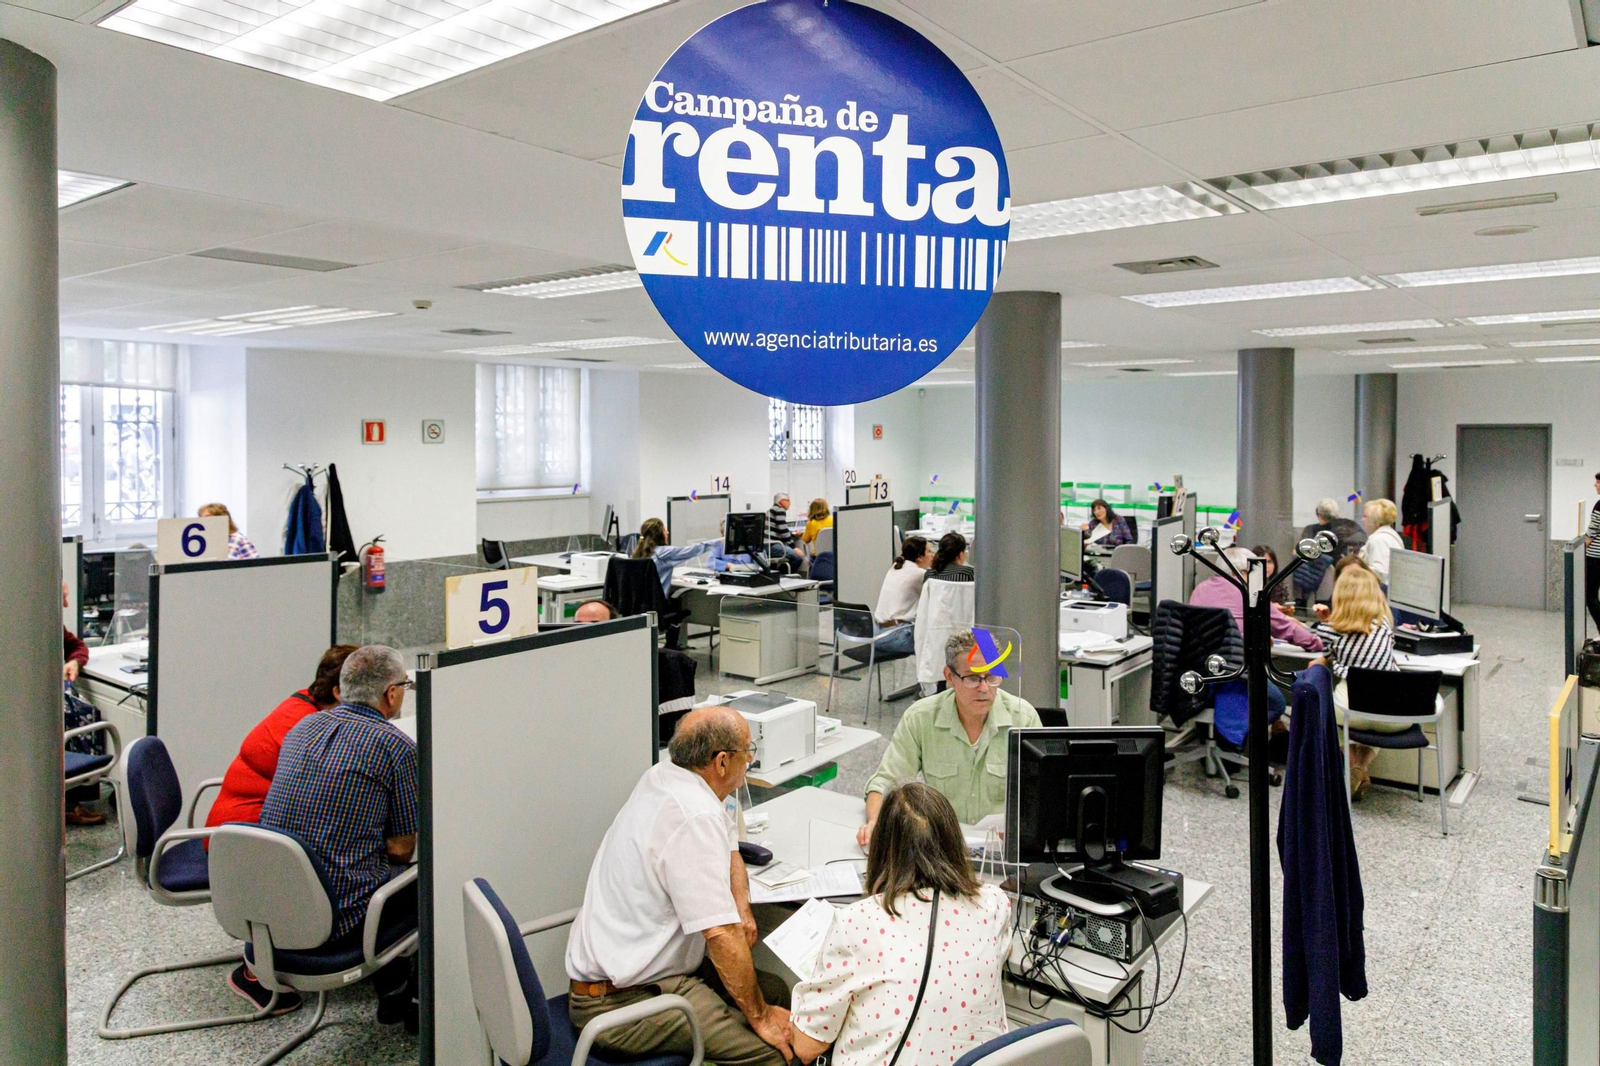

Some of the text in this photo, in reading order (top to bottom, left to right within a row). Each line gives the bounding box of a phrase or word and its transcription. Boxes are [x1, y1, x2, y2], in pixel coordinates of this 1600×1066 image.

[644, 80, 879, 132] Campaña de
[621, 114, 1011, 226] renta
[704, 331, 938, 352] www.agenciatributaria.es
[714, 476, 730, 492] 14
[845, 470, 857, 484] 20
[873, 481, 888, 500] 13
[181, 522, 207, 557] 6
[478, 579, 511, 634] 5
